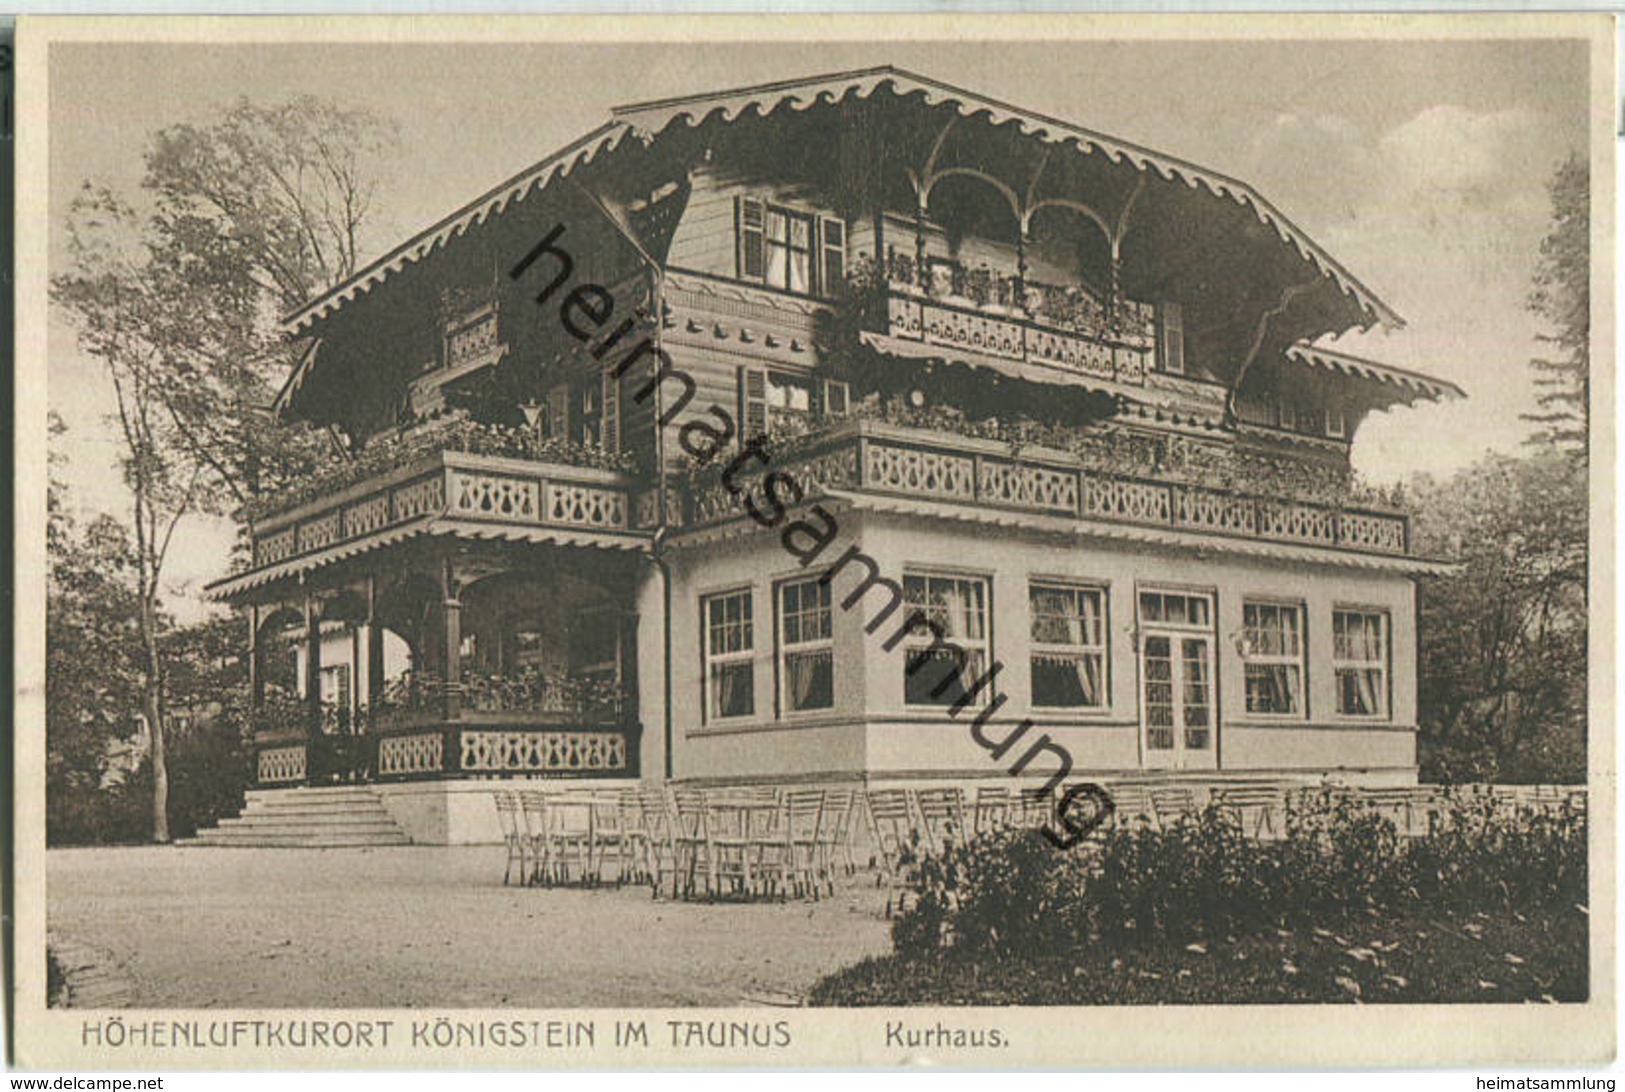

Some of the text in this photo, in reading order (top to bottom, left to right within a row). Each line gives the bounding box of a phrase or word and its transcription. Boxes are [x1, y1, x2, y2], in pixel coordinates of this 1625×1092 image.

[82, 1016, 792, 1047] HÖHENLUFTKURORT KÖNIGSTEIN IM TAUNUS
[885, 1020, 1009, 1048] Kurhaus.
